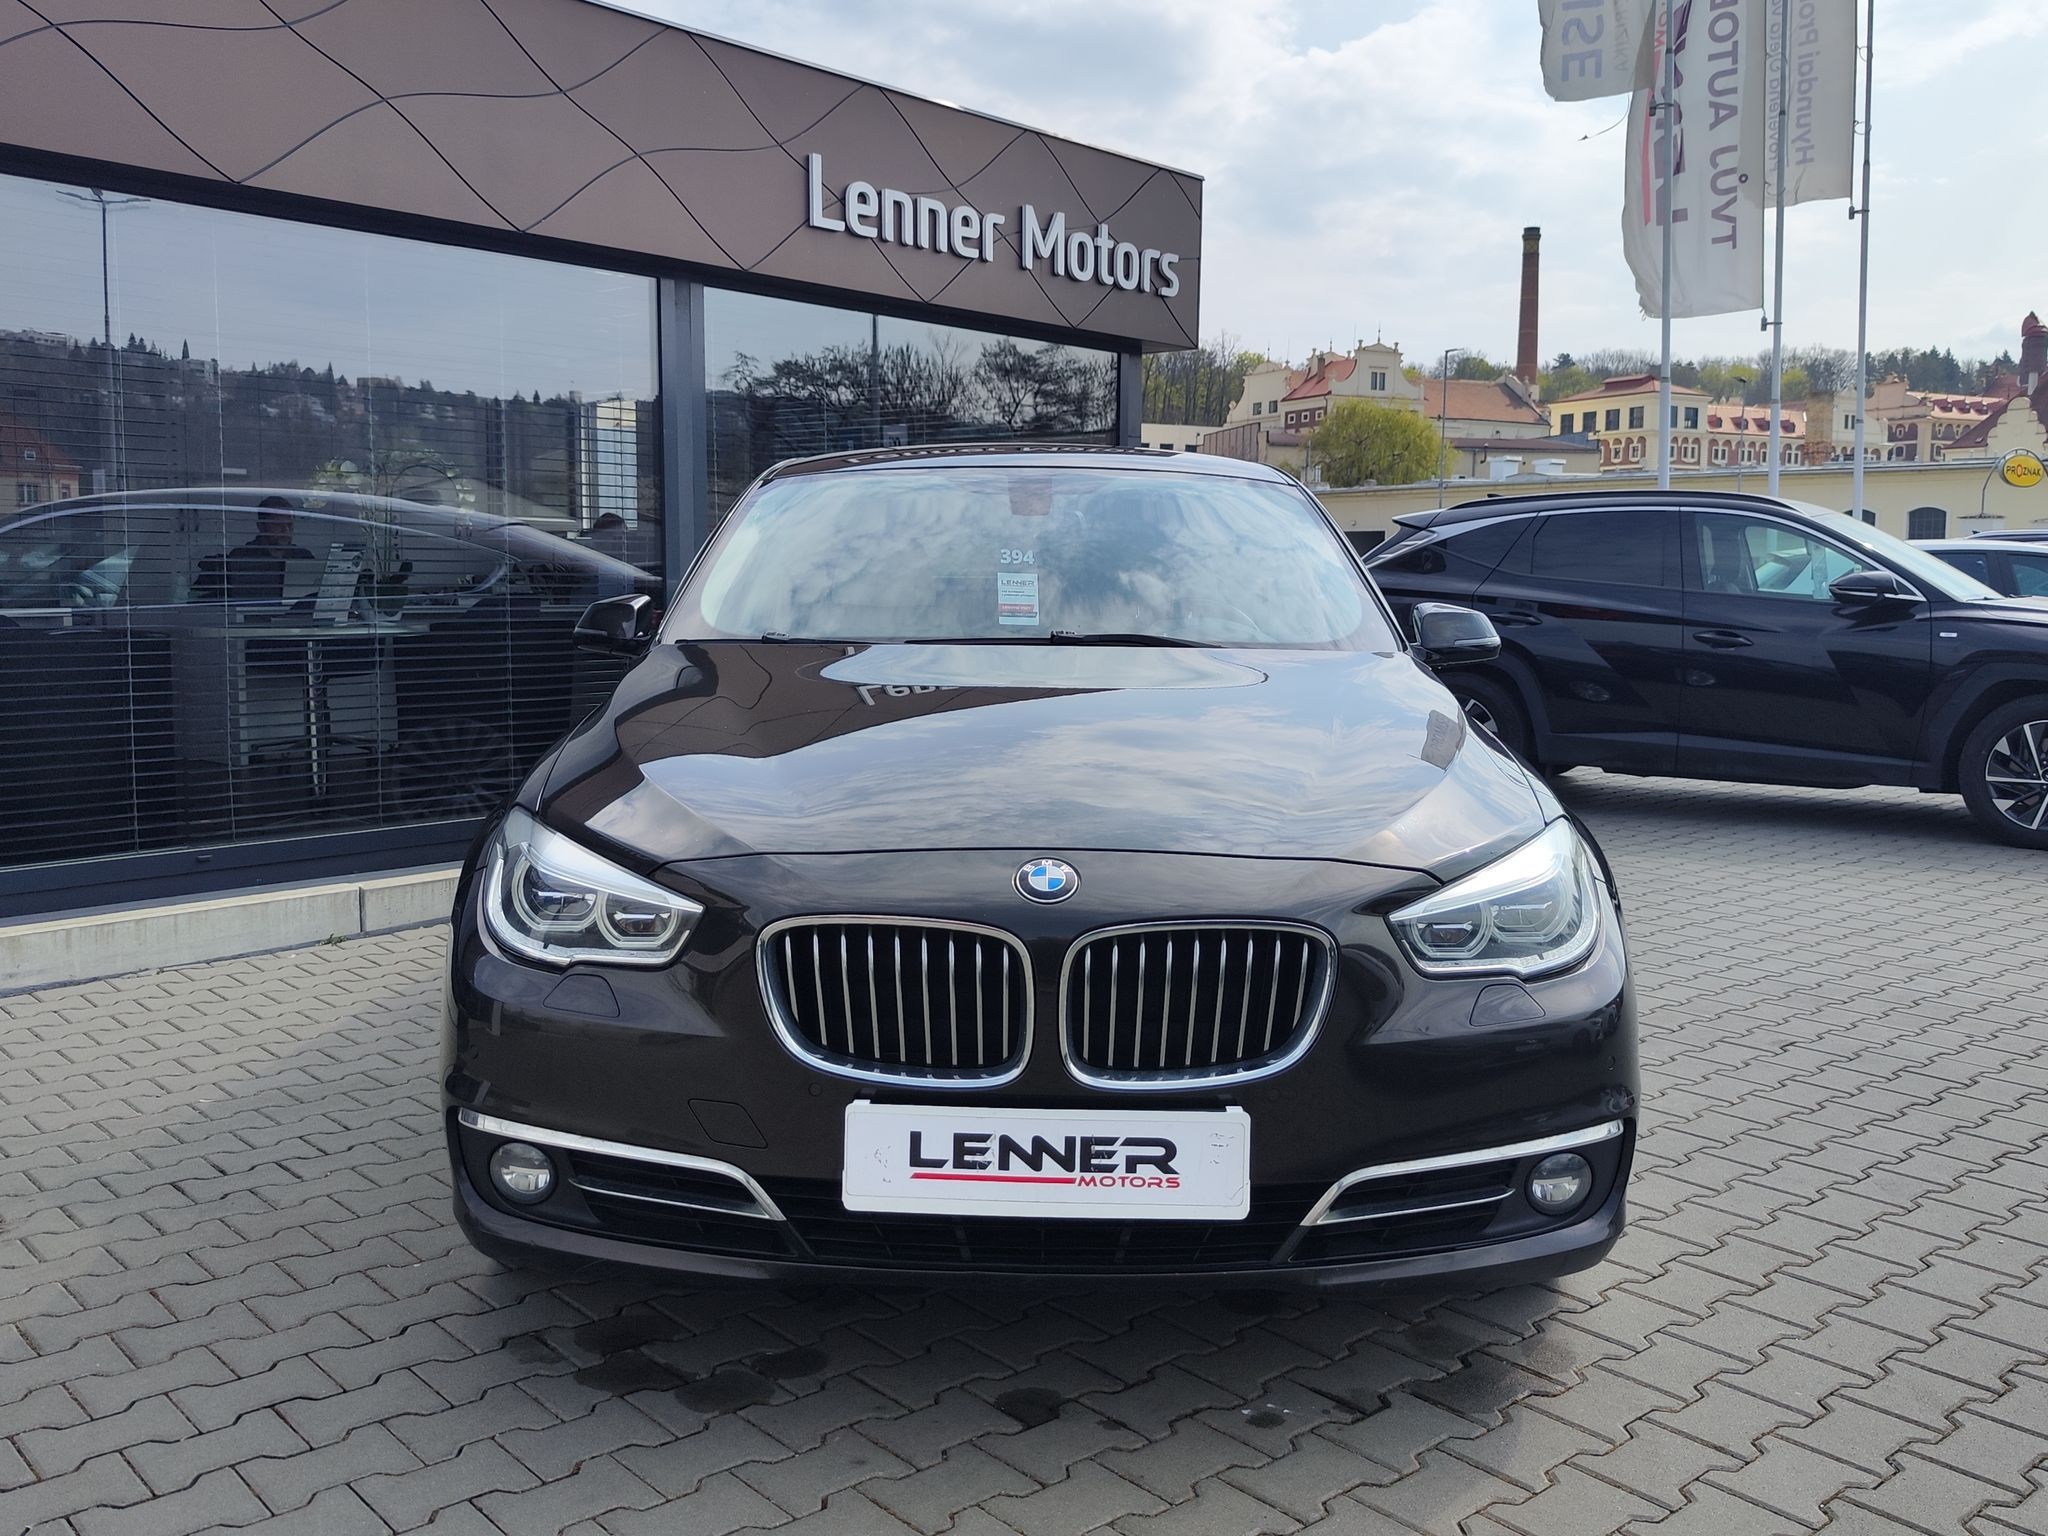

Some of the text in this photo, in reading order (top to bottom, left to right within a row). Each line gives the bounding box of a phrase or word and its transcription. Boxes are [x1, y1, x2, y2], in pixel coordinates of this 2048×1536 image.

[809, 152, 1180, 297] Lenner Motors
[1000, 548, 1035, 565] 394
[909, 1130, 1181, 1175] LENNER
[1077, 1174, 1181, 1189] MOTORS
